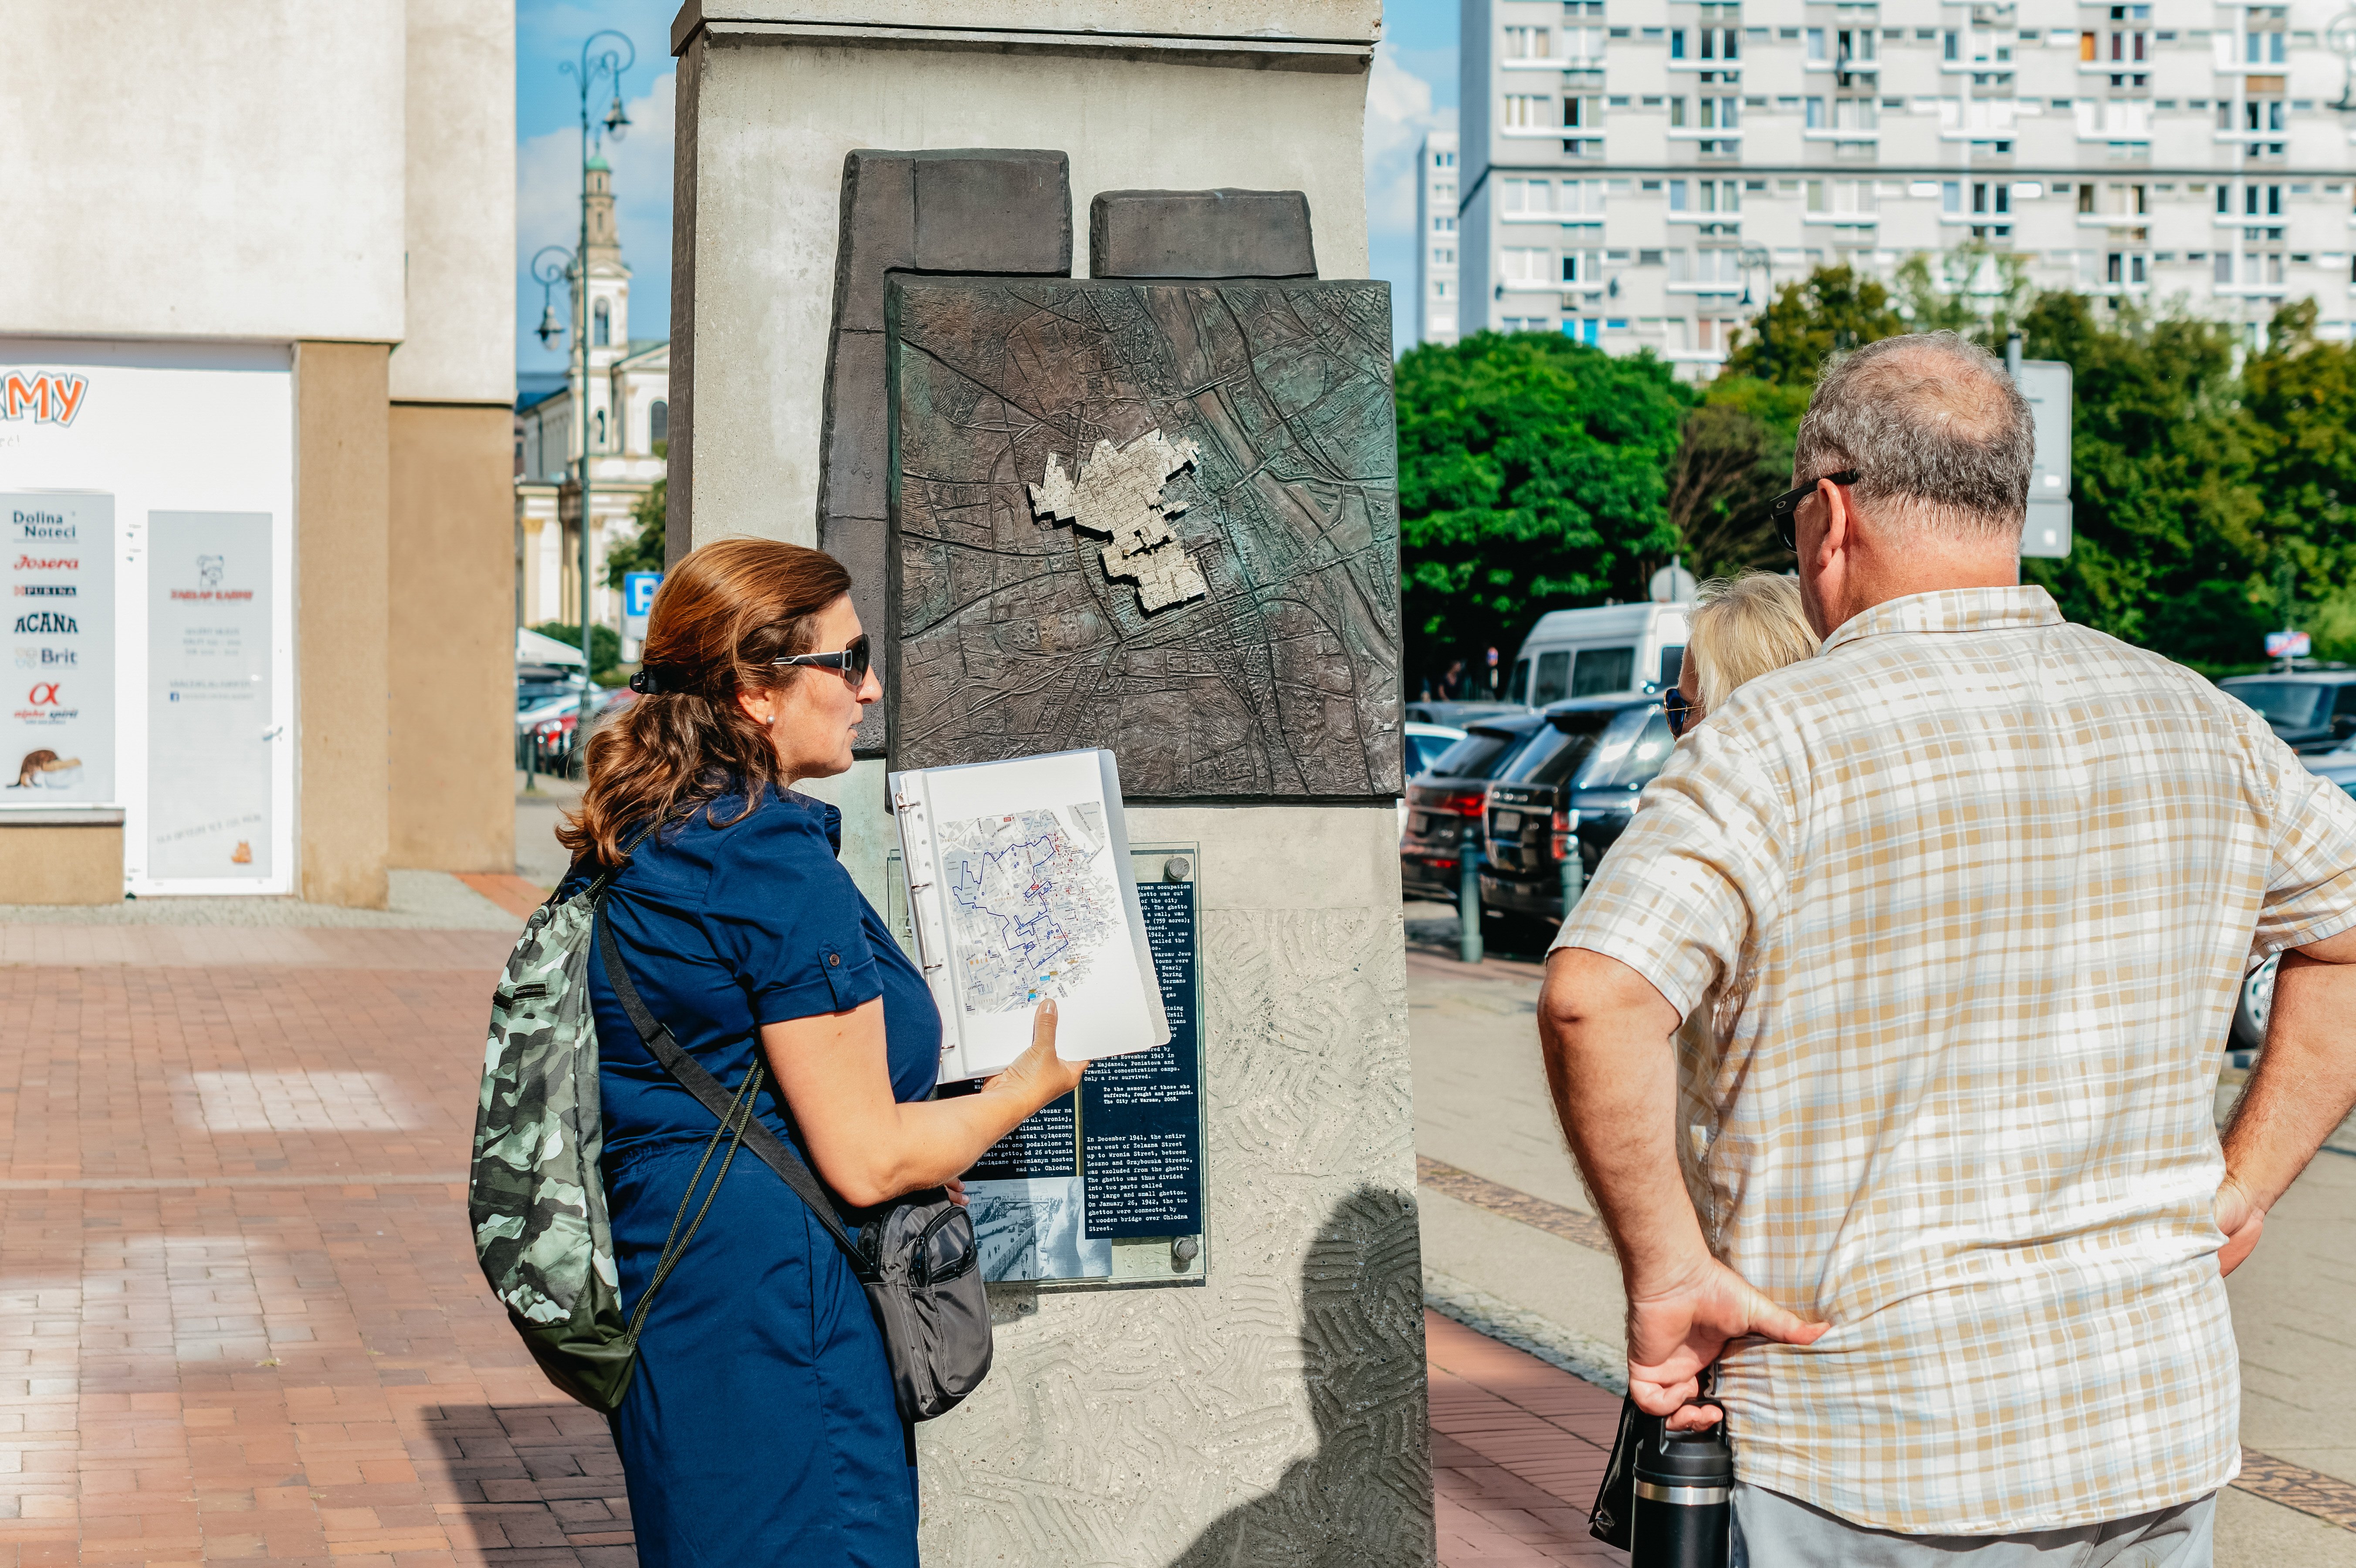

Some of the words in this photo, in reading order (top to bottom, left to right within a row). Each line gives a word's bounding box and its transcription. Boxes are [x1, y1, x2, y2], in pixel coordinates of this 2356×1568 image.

[0, 370, 89, 429] MY
[14, 510, 63, 524] Dolina
[24, 524, 75, 538] Noteci
[14, 554, 79, 570] Josera
[635, 577, 658, 612] P
[14, 611, 78, 633] ACANA
[41, 648, 78, 664] Brit
